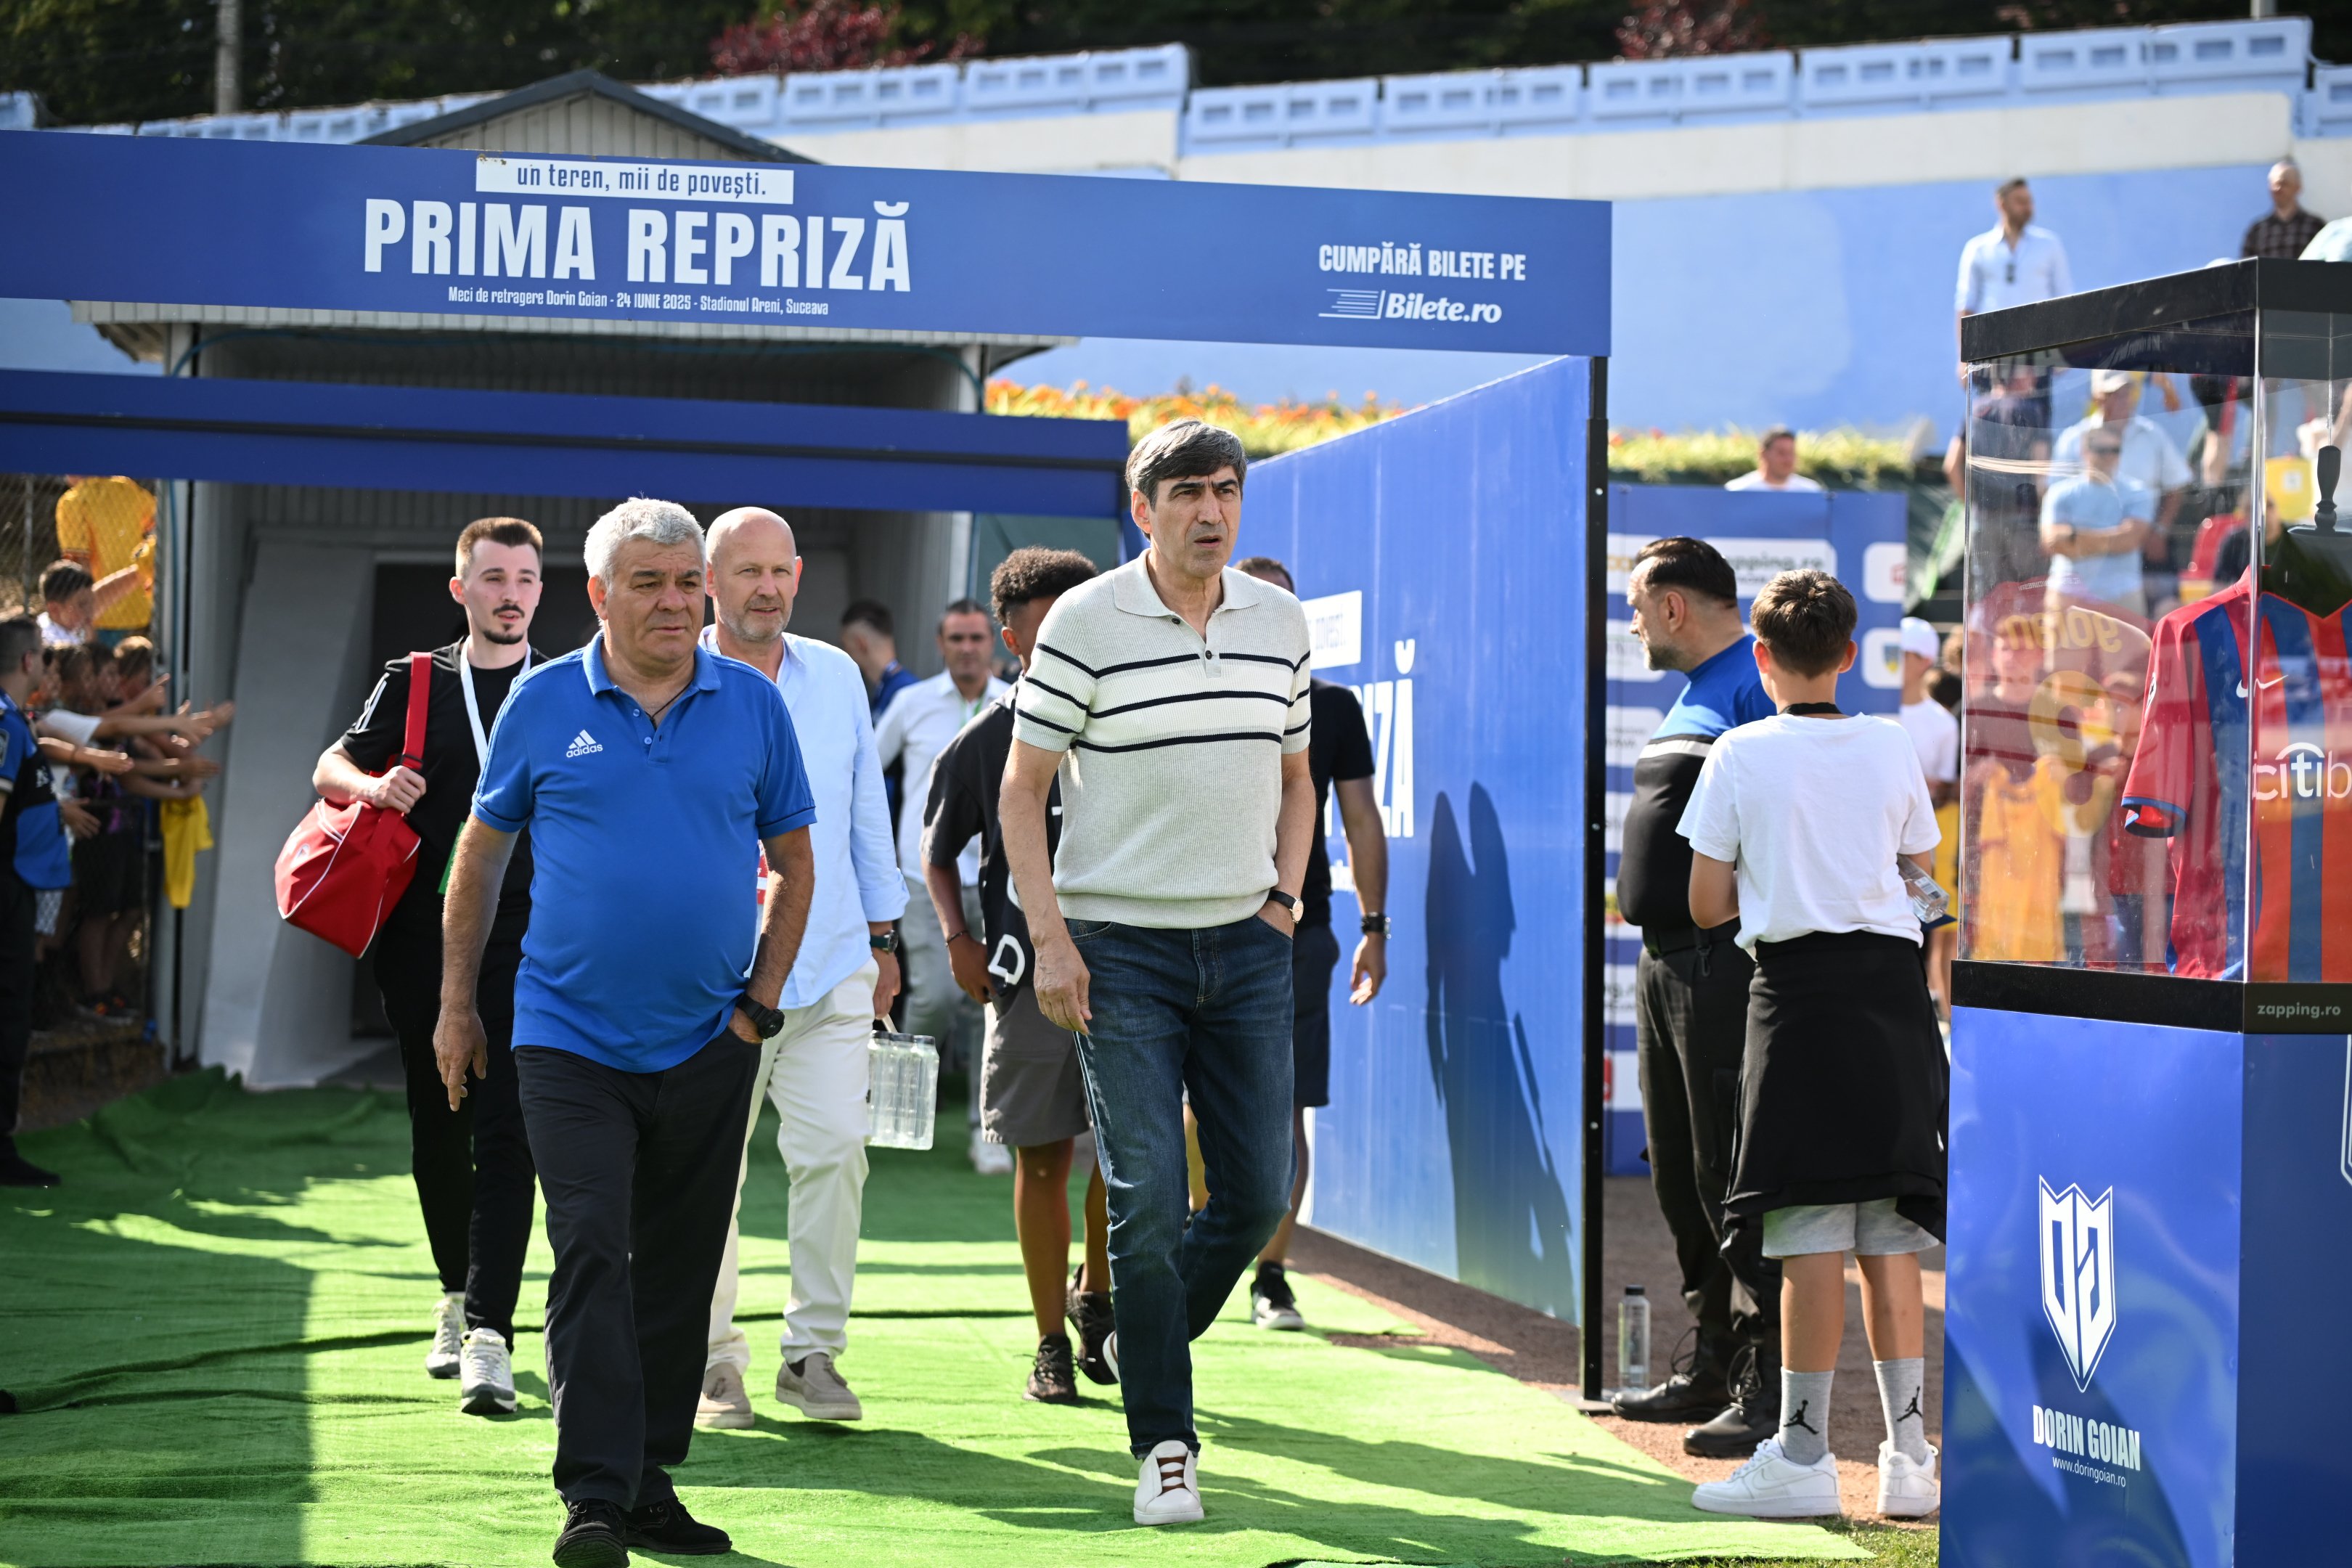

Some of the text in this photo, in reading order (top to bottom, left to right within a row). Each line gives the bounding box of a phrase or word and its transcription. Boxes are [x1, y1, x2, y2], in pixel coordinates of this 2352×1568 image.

[518, 164, 766, 199] un teren, mii de povești.
[364, 198, 911, 293] PRIMA REPRIZĂ
[1319, 241, 1526, 281] CUMPĂRĂ BILETE PE
[449, 287, 473, 302] Meci
[475, 287, 489, 303] de
[491, 289, 544, 306] retragere
[546, 290, 576, 306] Dorin
[578, 291, 608, 307] Goian
[616, 292, 632, 308] 24
[634, 294, 661, 309] IUNIE
[663, 295, 691, 310] 2025
[701, 295, 749, 312] Stadionul
[751, 298, 783, 315] Areni,
[786, 298, 829, 315] Suceava
[1384, 292, 1503, 323] Bilete.ro
[566, 744, 603, 758] adidas
[2257, 1002, 2341, 1018] zapping.ro
[2033, 1405, 2141, 1471] DORIN GOIAN
[2052, 1456, 2126, 1487] www.doringoian.ro
